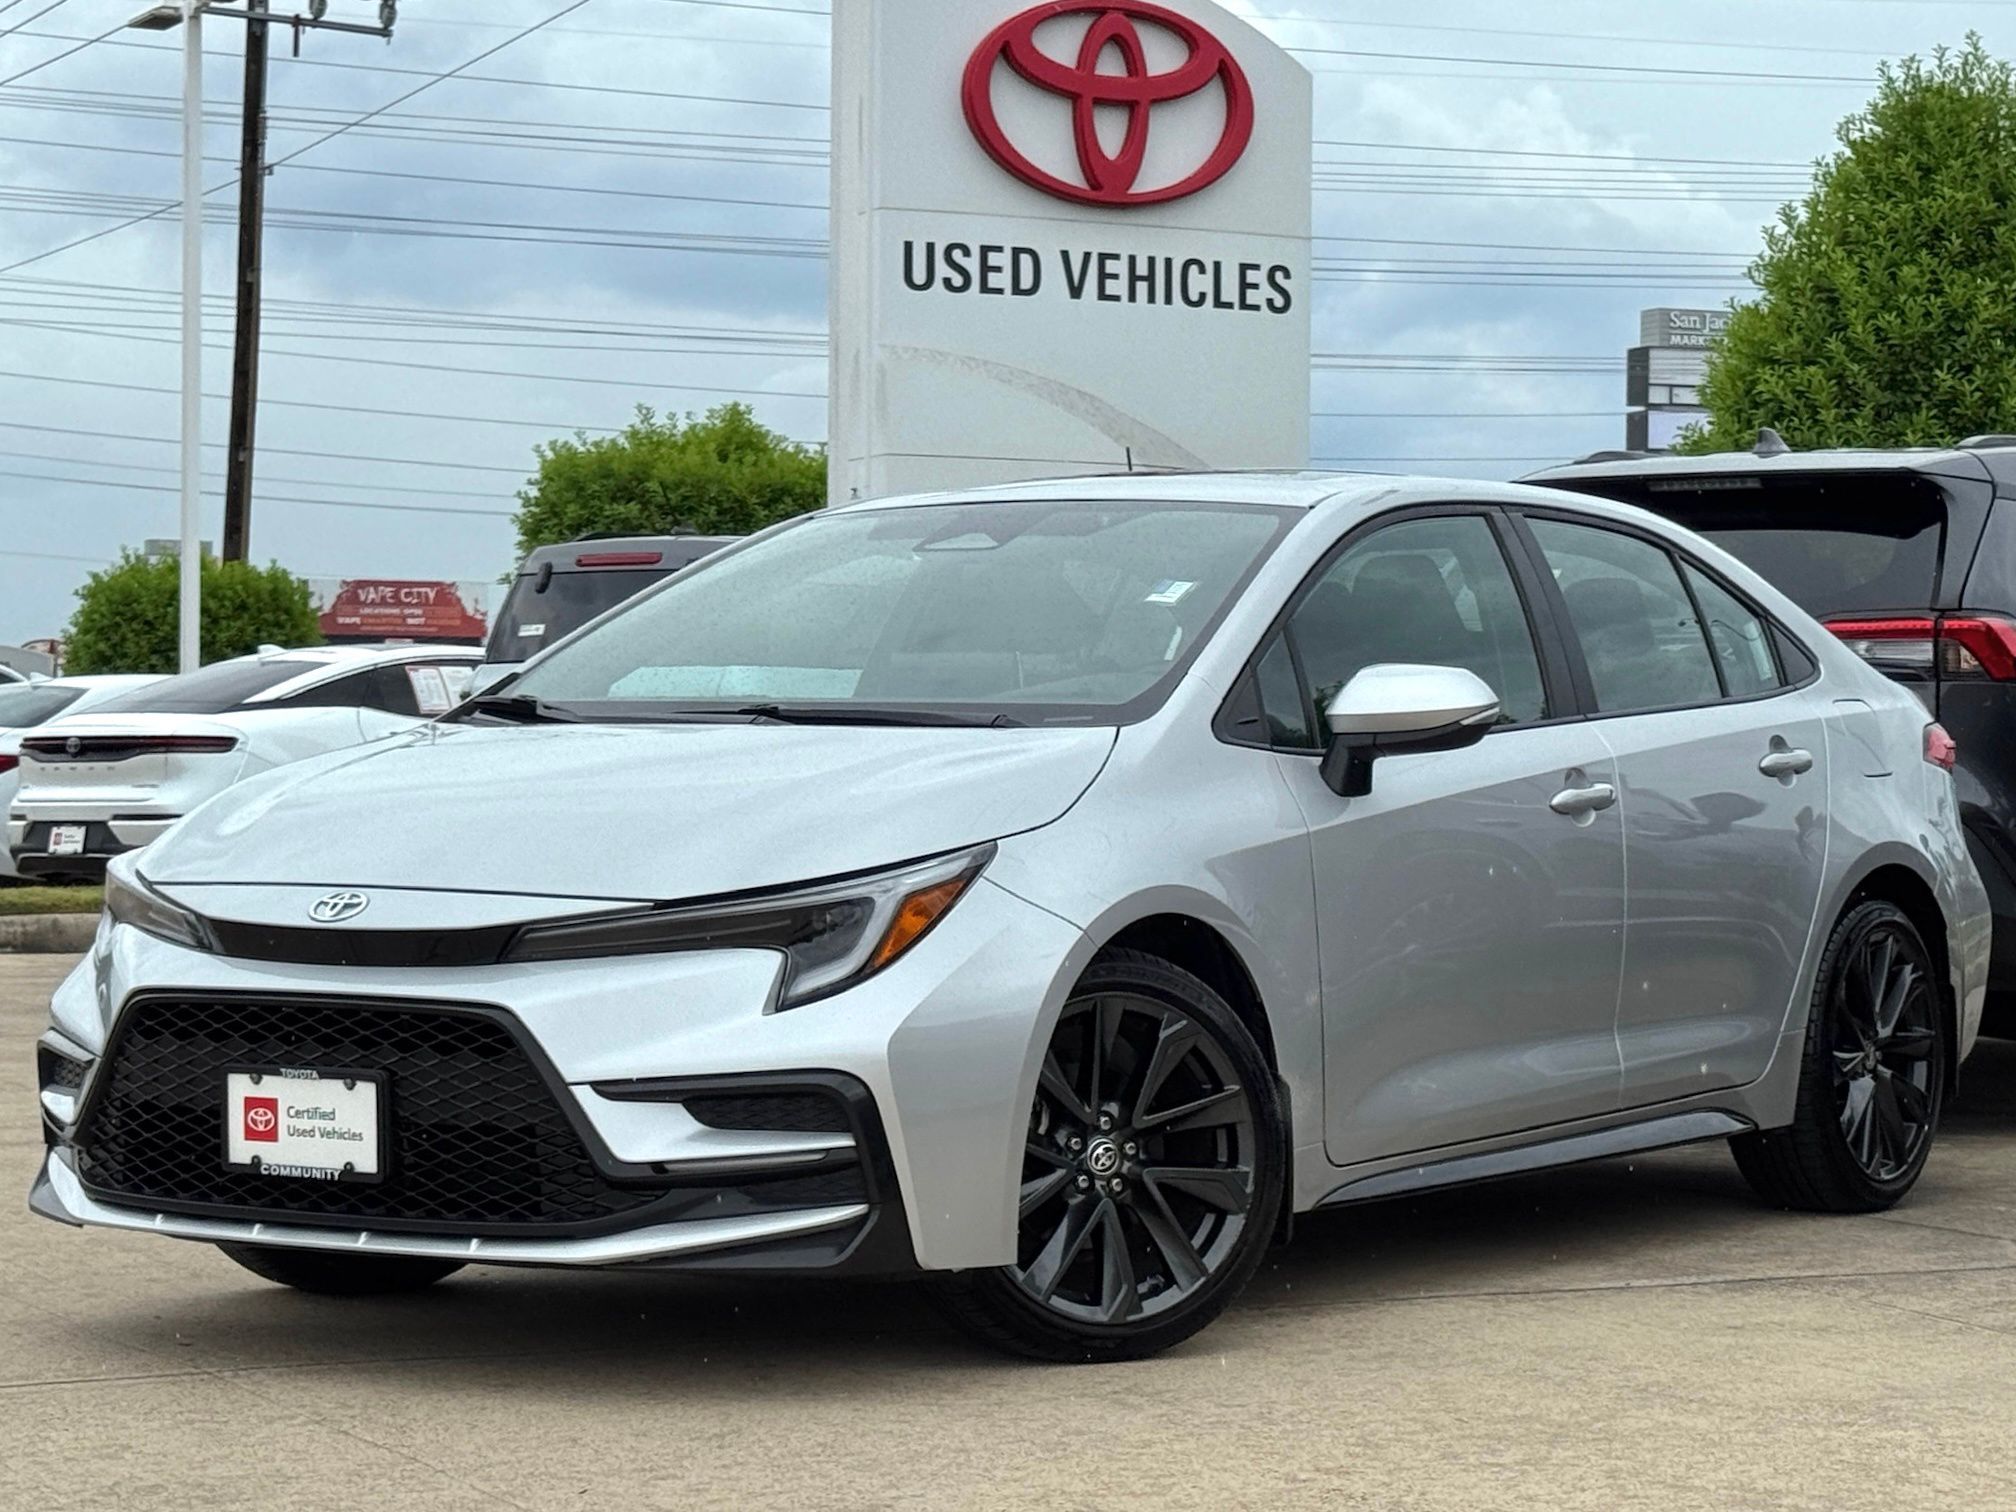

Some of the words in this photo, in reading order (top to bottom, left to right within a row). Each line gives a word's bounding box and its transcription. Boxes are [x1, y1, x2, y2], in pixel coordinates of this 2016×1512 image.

[903, 240, 1042, 297] USED
[1060, 249, 1292, 315] VEHICLES
[1669, 311, 1701, 329] San
[357, 586, 396, 604] VAPE
[400, 587, 438, 604] CITY
[280, 1068, 320, 1080] TOYOTA
[287, 1106, 336, 1121] Certified
[287, 1125, 316, 1138] Used
[317, 1127, 364, 1142] Vehicles
[260, 1164, 341, 1181] COMMUNITY
